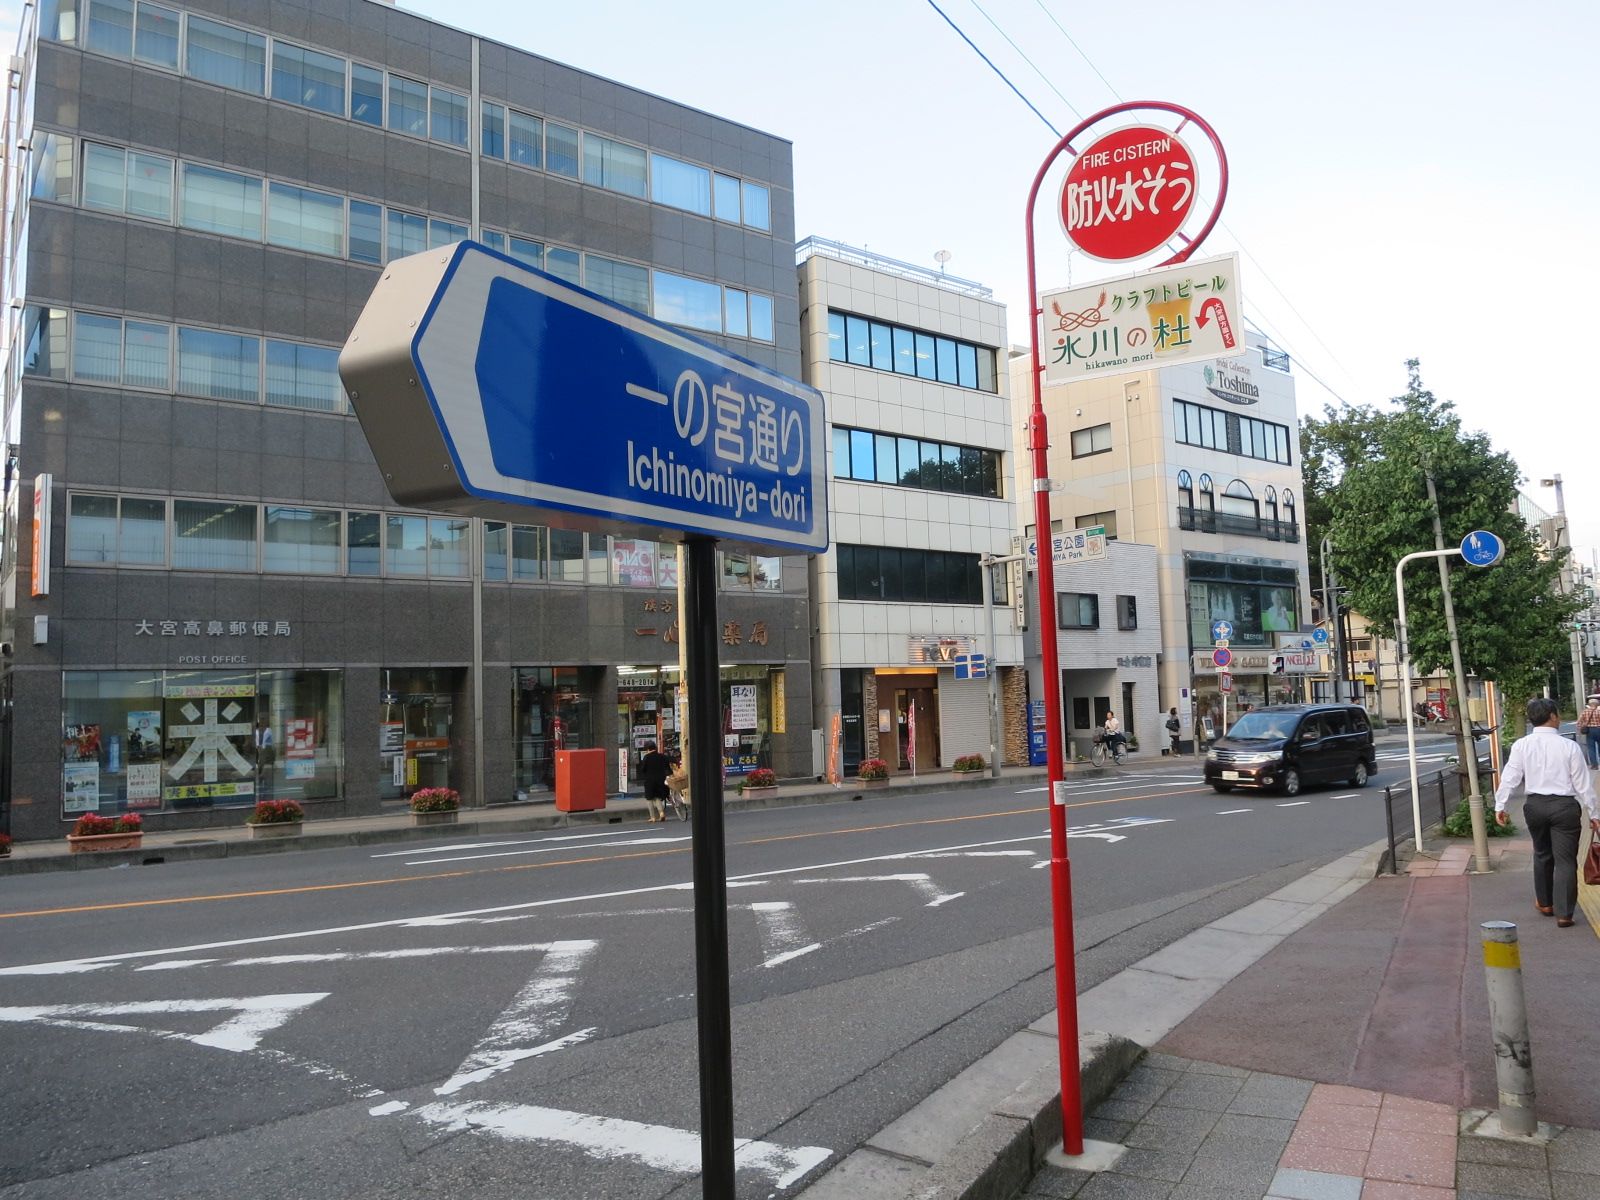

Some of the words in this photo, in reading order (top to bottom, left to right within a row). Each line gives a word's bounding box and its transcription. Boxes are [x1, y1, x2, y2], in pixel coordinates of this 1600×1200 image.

[1082, 151, 1110, 170] FIRE
[1113, 137, 1171, 163] CISTERN
[1067, 161, 1192, 231] 防火水そう
[1111, 275, 1227, 313] クラフトビール
[1052, 314, 1193, 365] 氷川の杜
[1085, 357, 1128, 370] hikawano
[1132, 352, 1153, 363] mori
[1217, 370, 1259, 397] Toshima
[625, 369, 804, 476] 一の宮通り
[627, 440, 806, 523] Ichinomiya-dori
[1053, 534, 1085, 552] 宮公園
[1068, 551, 1083, 560] Park
[135, 619, 291, 637] 大宮高鼻郵便局
[179, 655, 206, 664] POST
[211, 655, 248, 664] OFFICE
[732, 686, 757, 697] 耳なり
